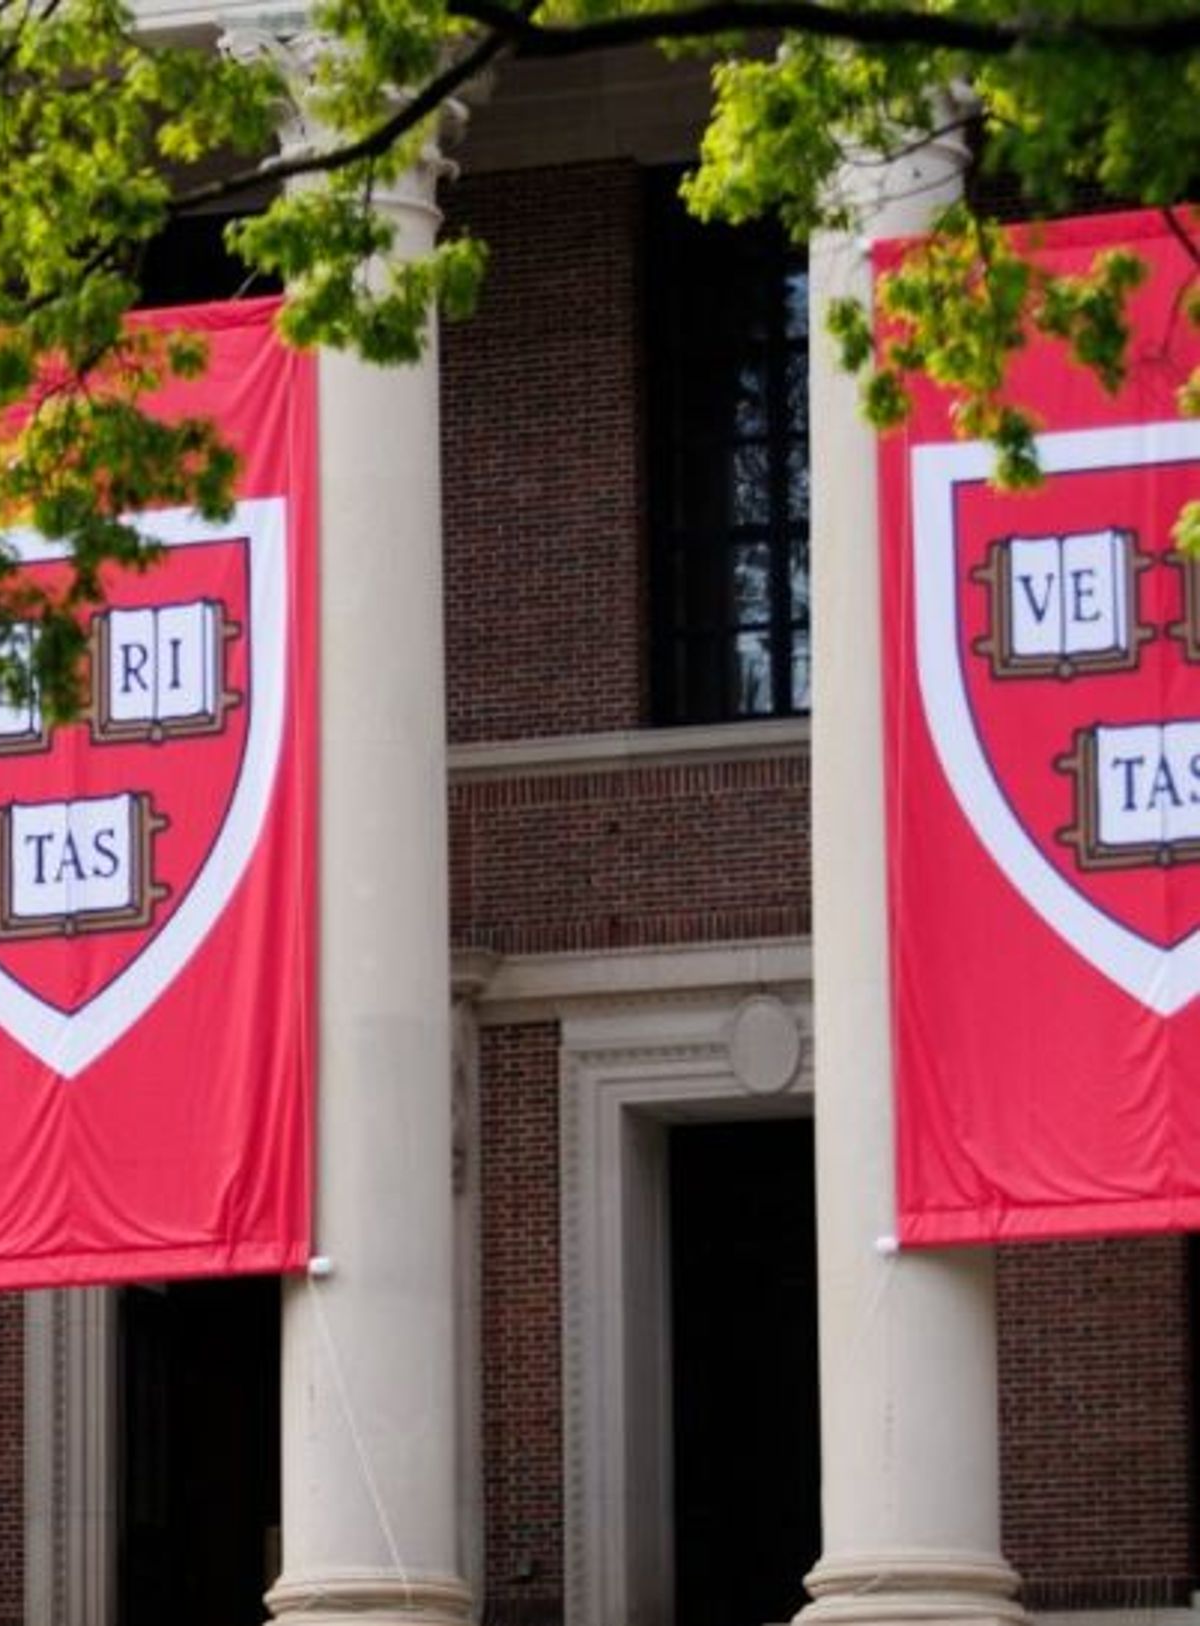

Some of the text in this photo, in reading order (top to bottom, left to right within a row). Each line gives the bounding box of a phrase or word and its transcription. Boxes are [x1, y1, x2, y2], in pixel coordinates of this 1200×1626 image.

[1016, 568, 1101, 624] VE
[120, 638, 182, 694] RI
[25, 828, 120, 885] TAS
